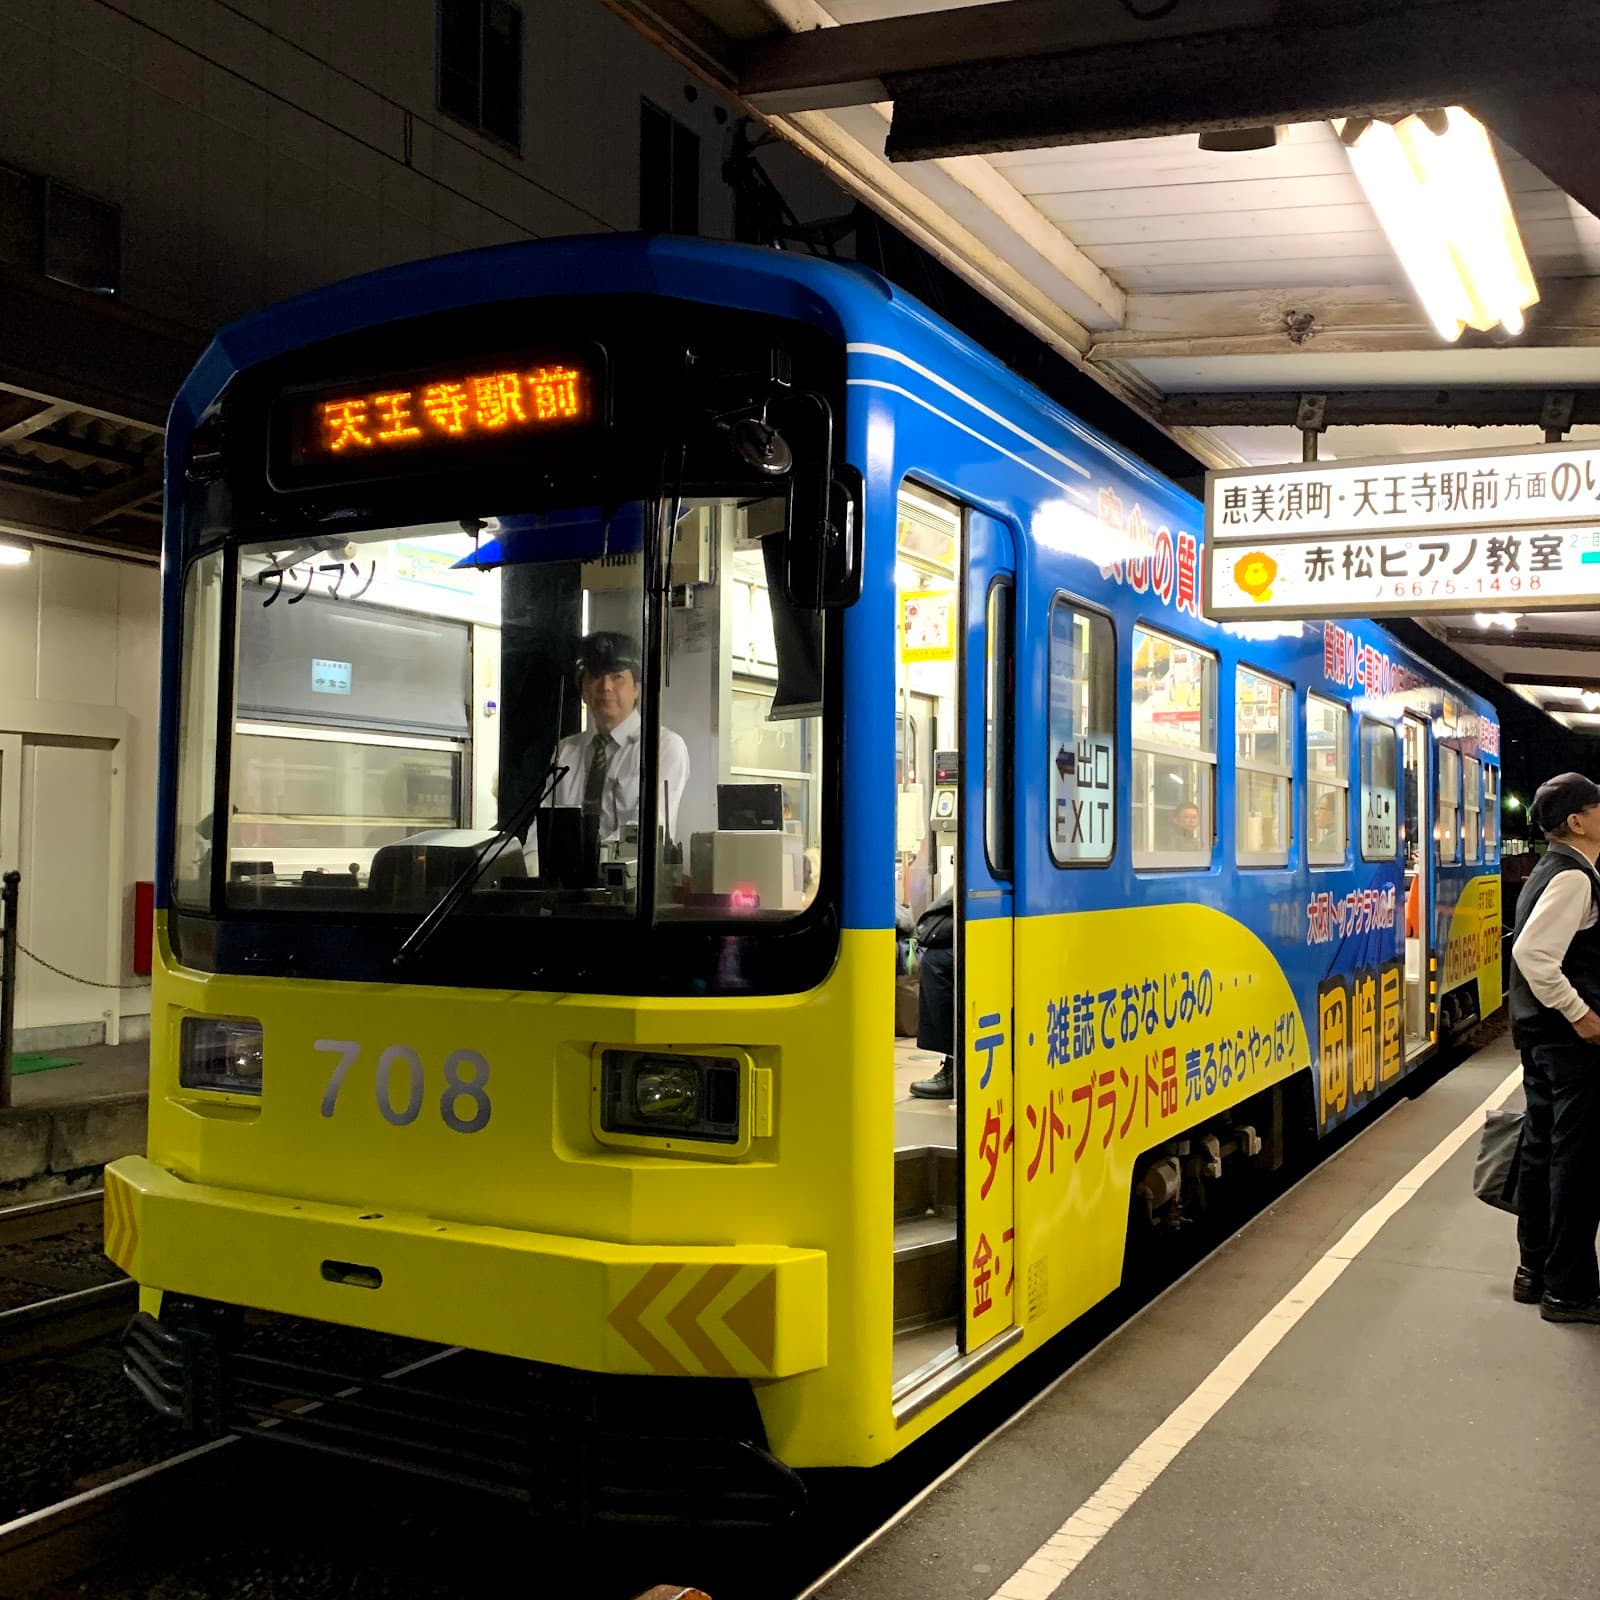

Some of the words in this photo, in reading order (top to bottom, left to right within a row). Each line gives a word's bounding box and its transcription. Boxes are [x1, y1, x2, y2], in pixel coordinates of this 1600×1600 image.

[325, 365, 578, 450] 天王寺駅前
[1304, 533, 1565, 582] 赤松ピアノ教室
[257, 560, 376, 607] ワンマン
[1077, 739, 1110, 790] 出口
[1055, 798, 1109, 844] EXIT
[1367, 791, 1382, 818] 入口
[1367, 824, 1391, 849] ENTRANCE
[313, 1039, 492, 1134] 708
